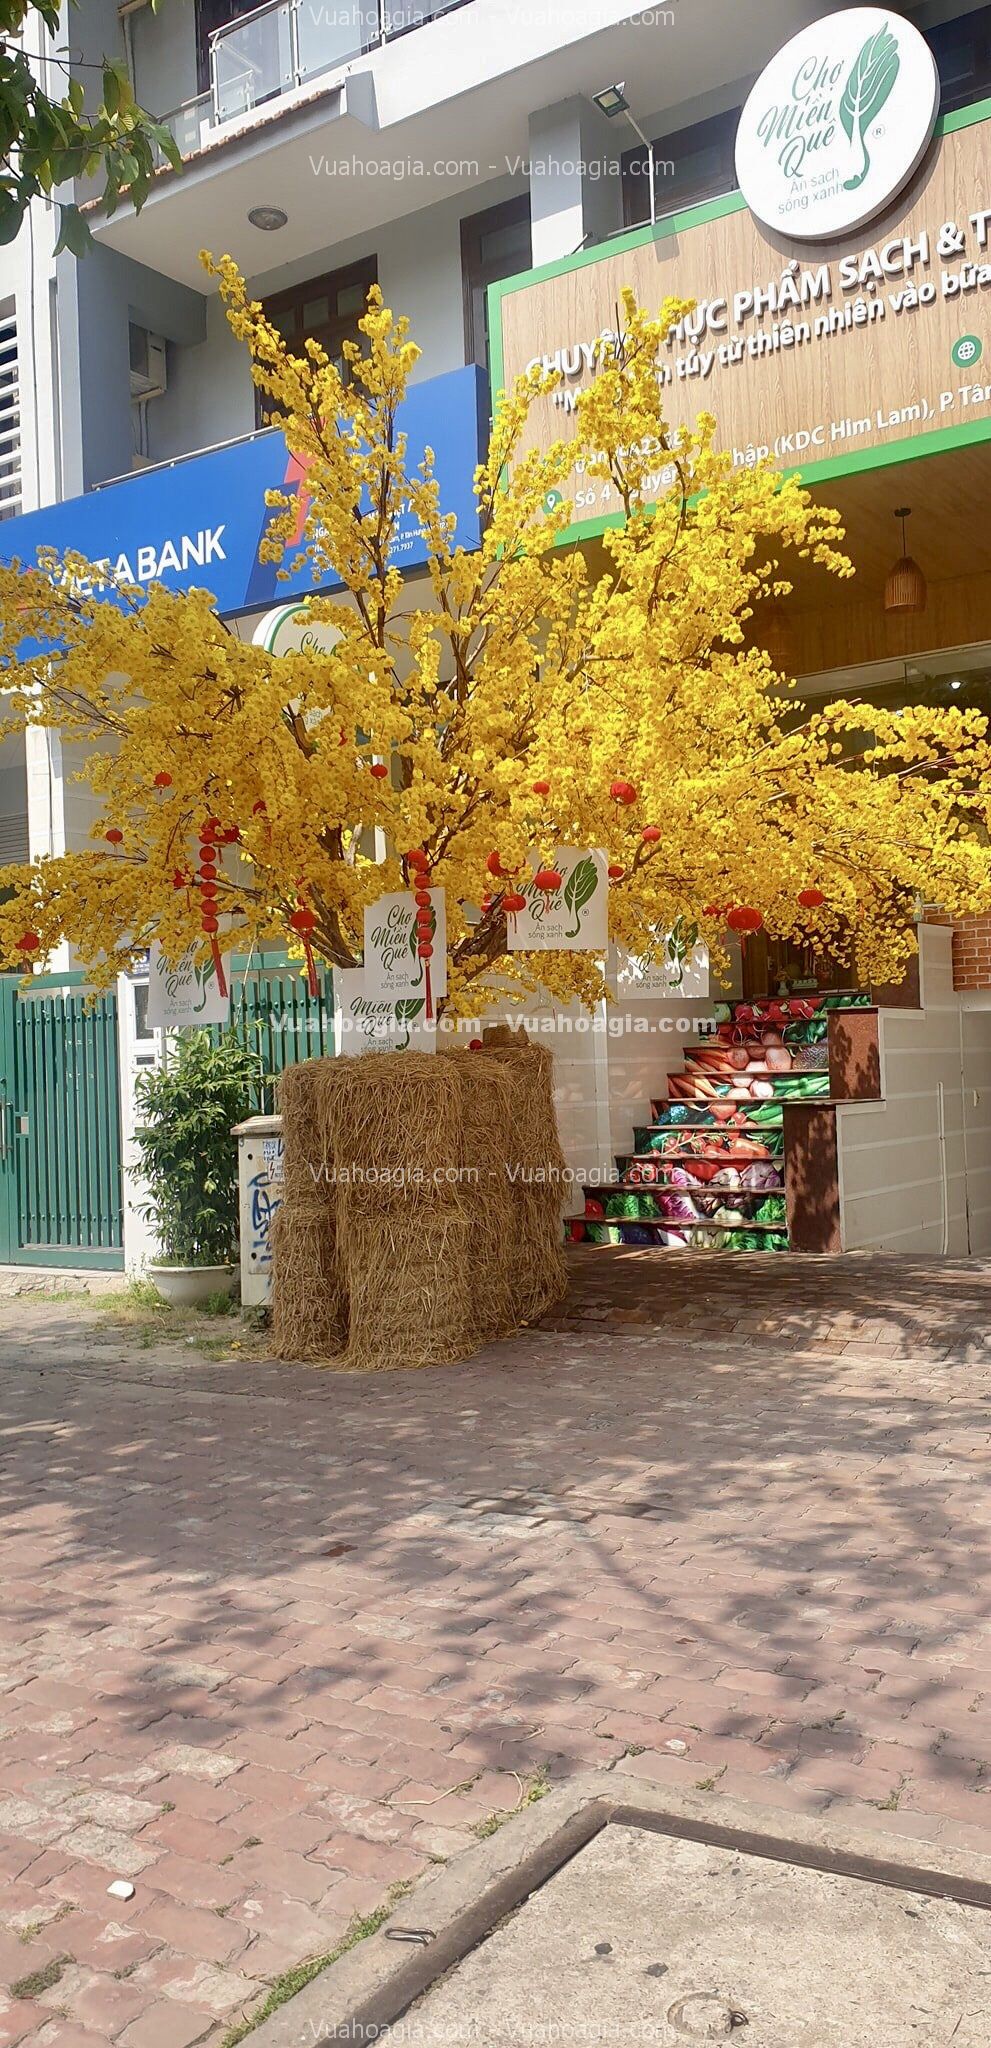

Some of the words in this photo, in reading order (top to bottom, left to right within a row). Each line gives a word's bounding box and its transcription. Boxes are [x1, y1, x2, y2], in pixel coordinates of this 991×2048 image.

[733, 259, 832, 323] PHẨM
[838, 231, 930, 292] SẠCH
[937, 221, 966, 256] &
[717, 335, 745, 364] từ
[747, 319, 811, 356] thiên
[814, 297, 885, 336] nhiên
[888, 281, 936, 312] vào
[575, 483, 596, 508] Số
[601, 484, 611, 501] 4
[774, 424, 826, 458] (KDC
[830, 417, 872, 442] Him
[371, 925, 407, 948] Miền
[387, 904, 413, 929] Chợ
[381, 943, 409, 971] Quê
